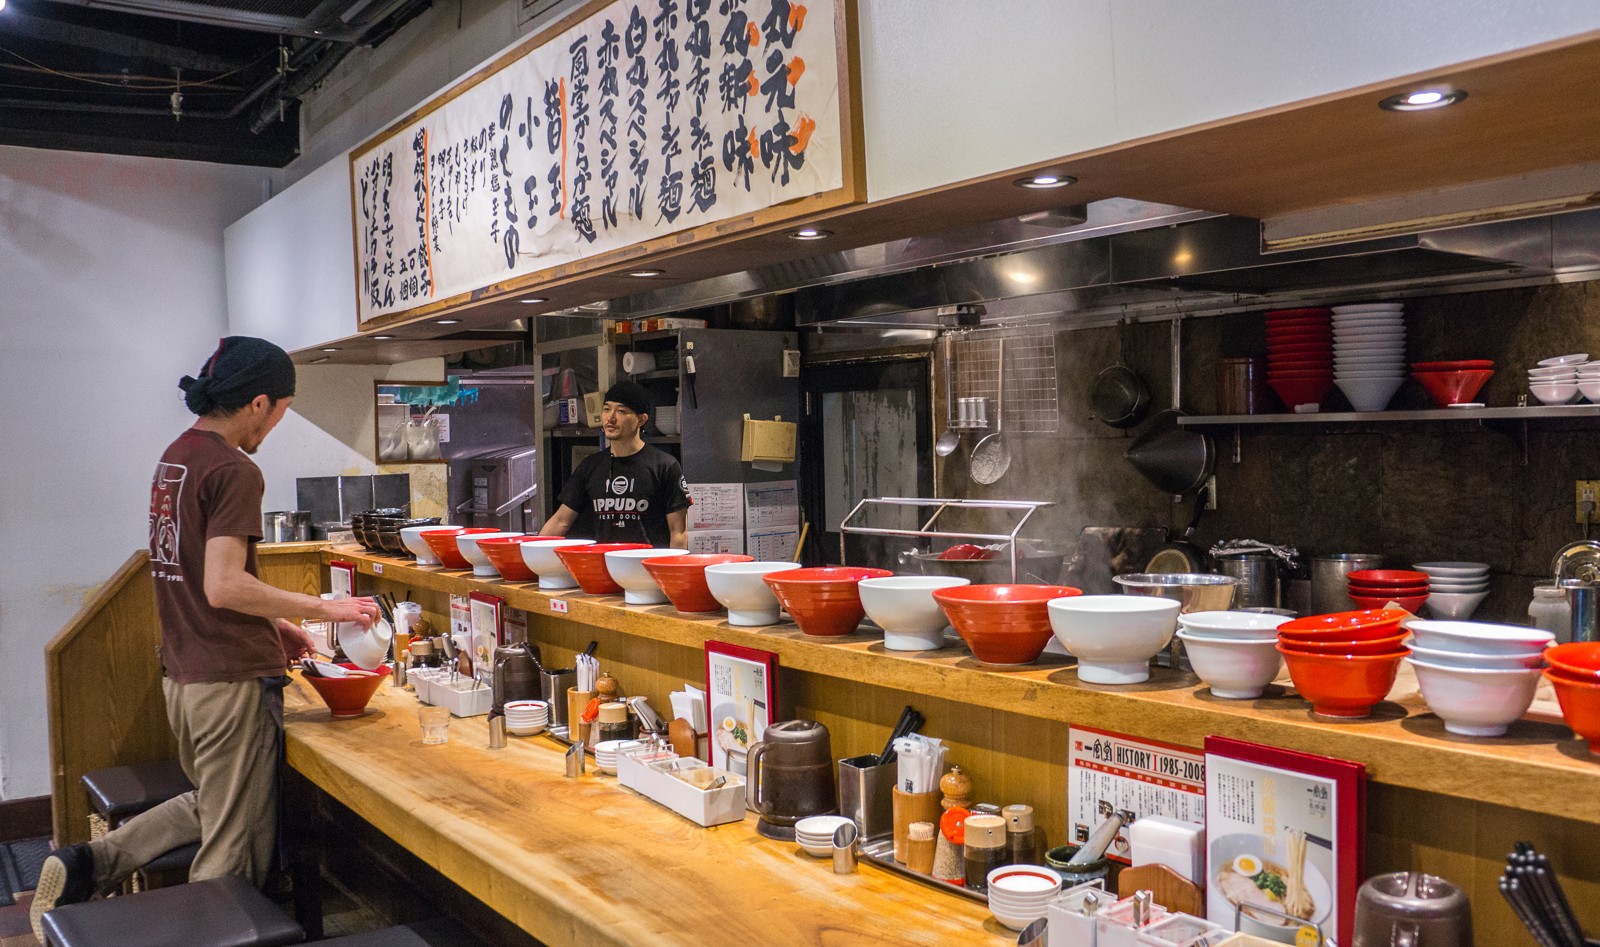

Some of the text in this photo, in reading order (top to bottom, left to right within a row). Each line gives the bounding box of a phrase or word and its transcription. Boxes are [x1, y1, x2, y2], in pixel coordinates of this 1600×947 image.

[597, 19, 621, 229] 赤丸スペシャル
[625, 4, 649, 221] 白丸スペシャル
[593, 498, 649, 512] IPPUDO
[1084, 738, 1113, 763] 一風堂
[1116, 746, 1151, 770] HISTORY
[1159, 757, 1205, 782] 1985-2008
